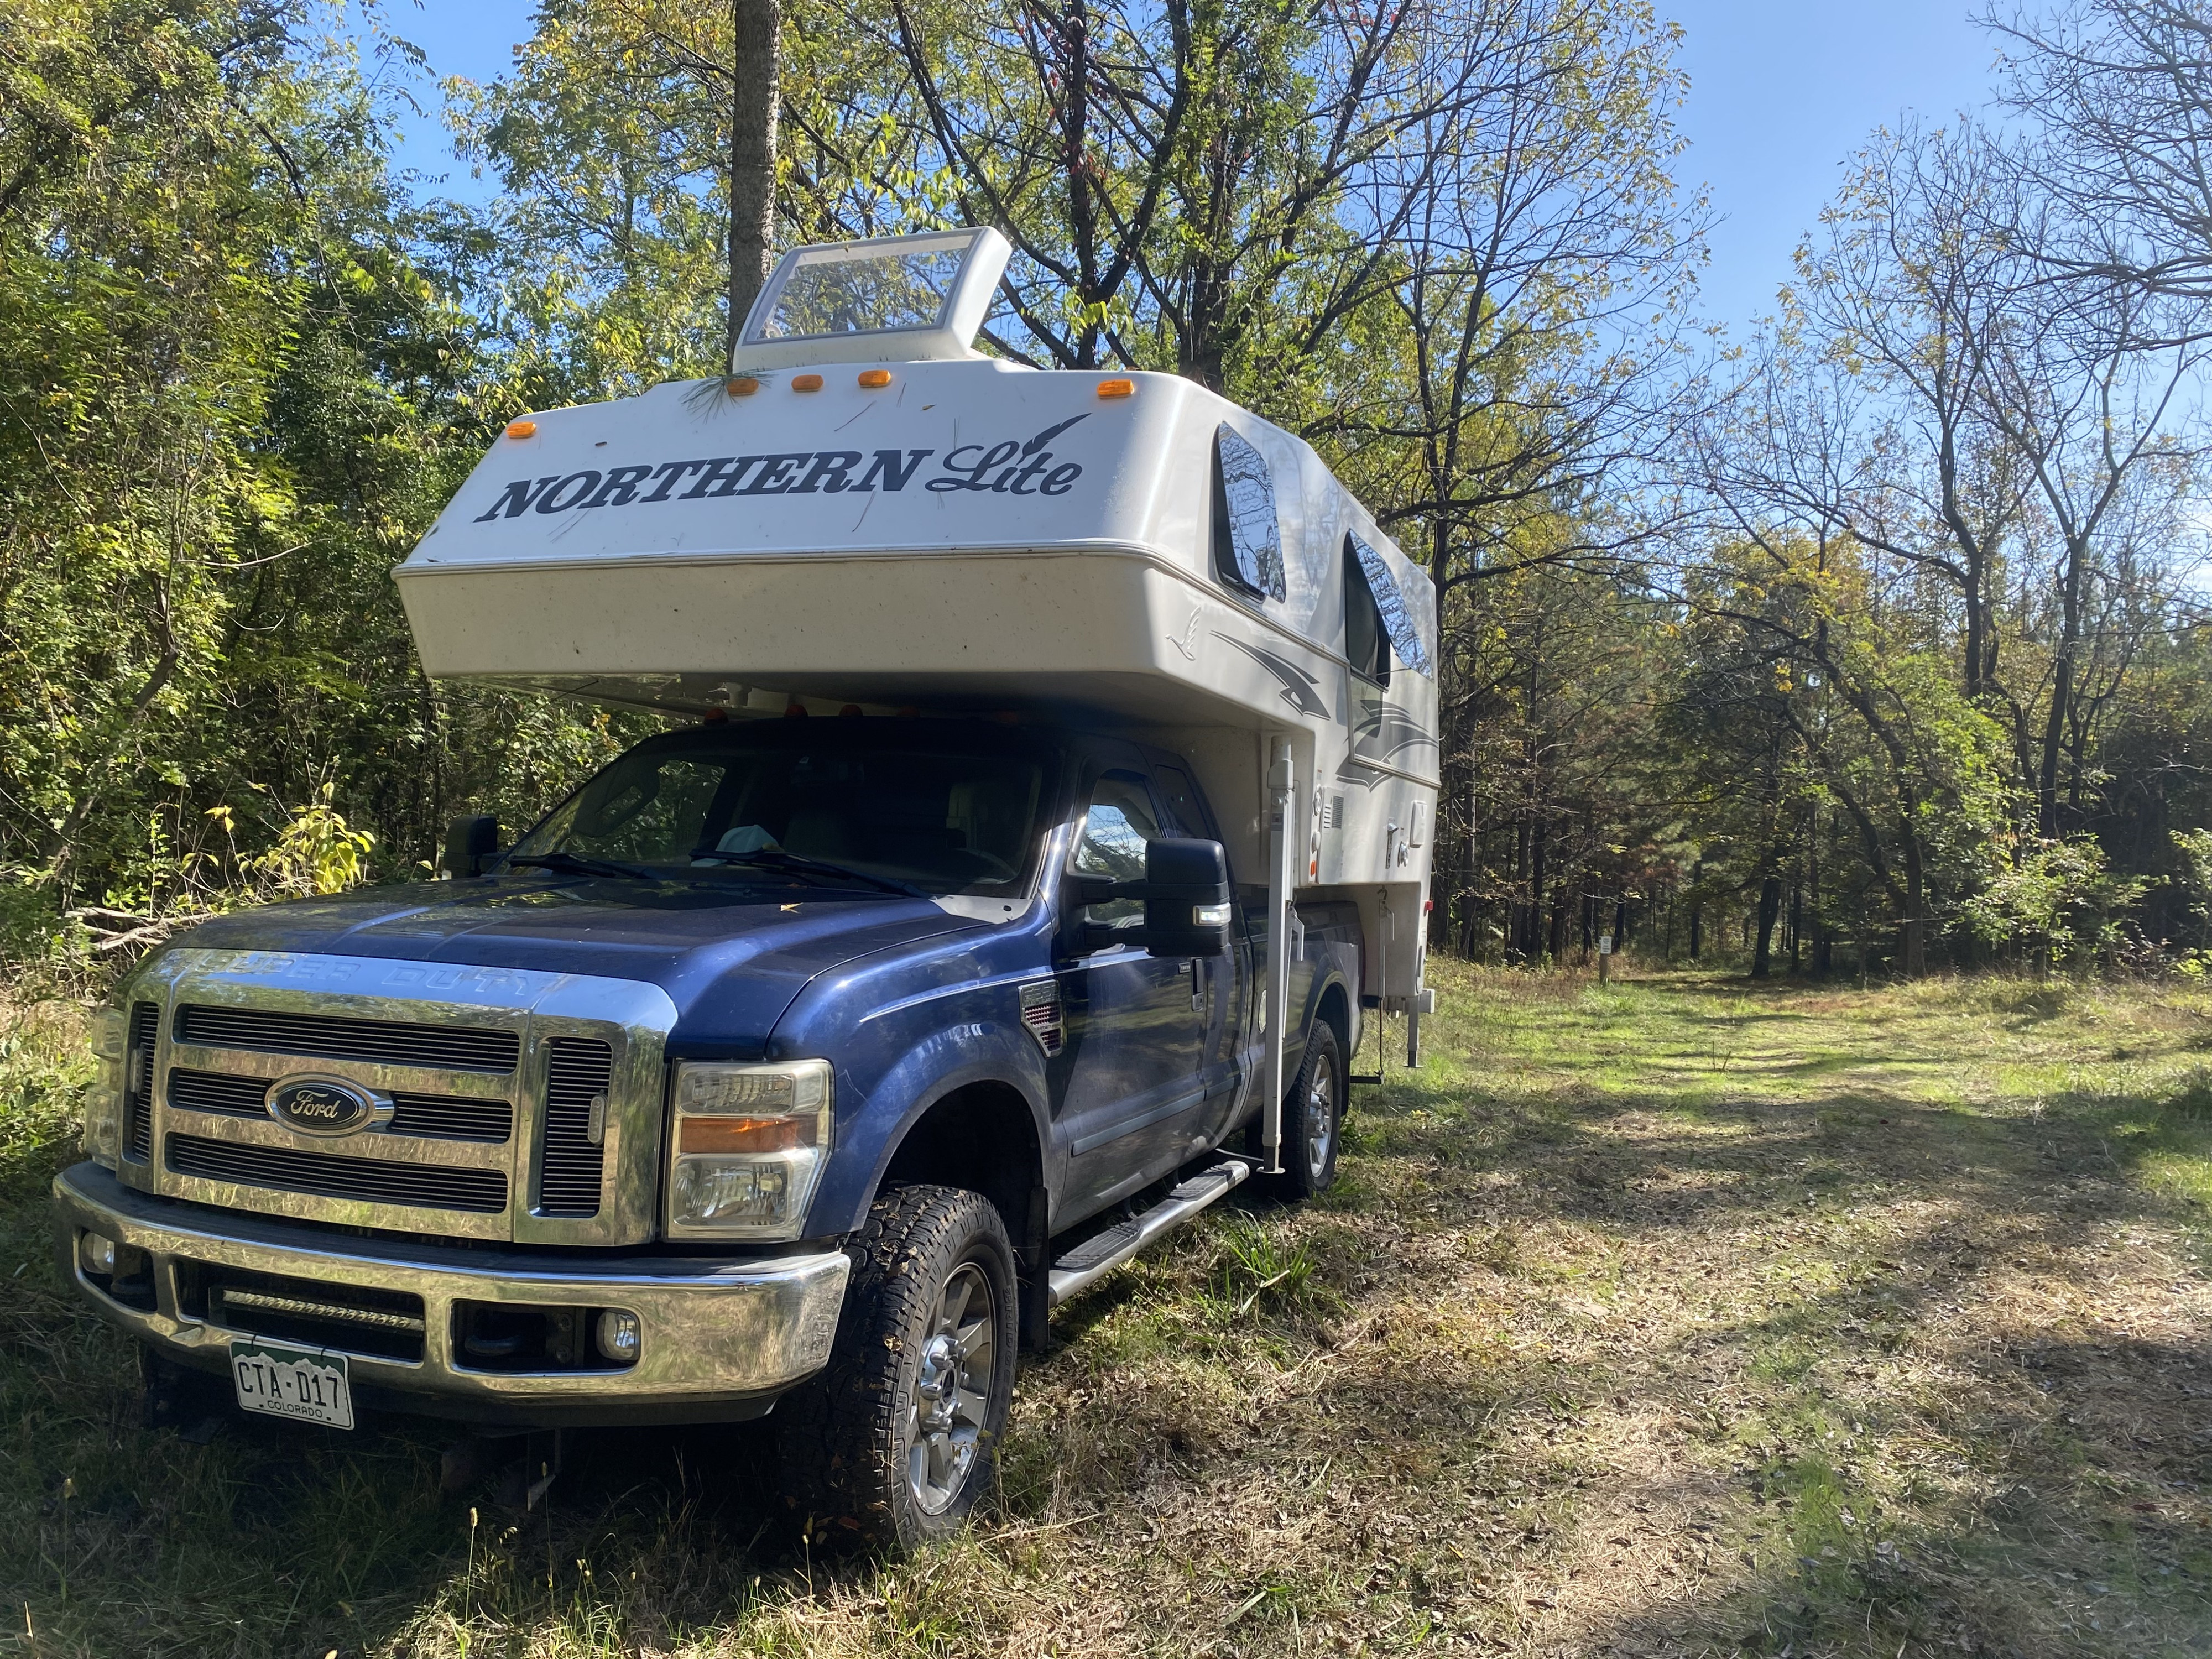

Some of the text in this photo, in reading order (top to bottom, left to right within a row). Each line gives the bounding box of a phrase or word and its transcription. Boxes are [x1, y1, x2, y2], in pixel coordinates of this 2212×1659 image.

[474, 426, 1085, 523] NORTHERN Lite
[291, 1090, 341, 1118] Ford
[267, 1400, 322, 1418] COLORADO
